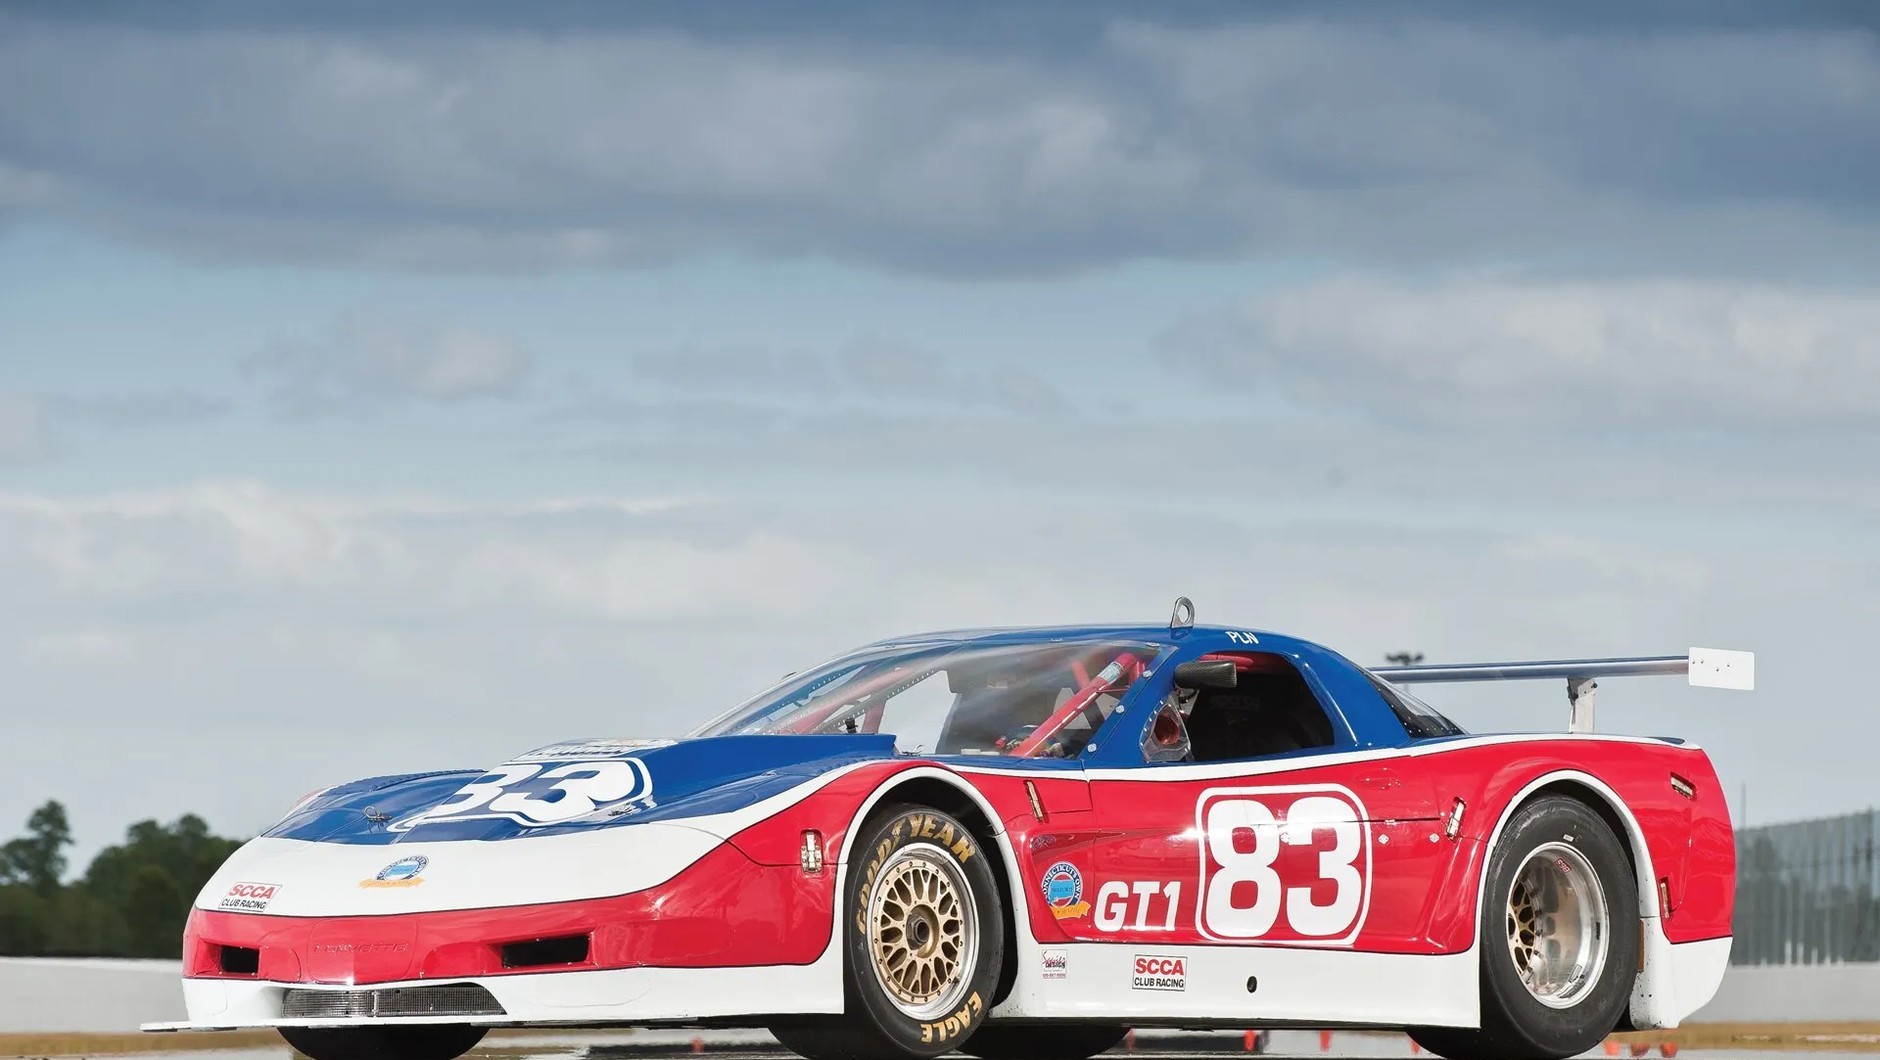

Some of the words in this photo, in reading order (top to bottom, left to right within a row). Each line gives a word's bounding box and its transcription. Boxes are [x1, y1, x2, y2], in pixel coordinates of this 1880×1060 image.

[1225, 631, 1259, 644] PLN
[1205, 796, 1362, 938] 83
[229, 884, 275, 899] SCCA
[221, 898, 240, 907] CLUB
[239, 900, 266, 909] RACING
[1094, 881, 1181, 932] GT1
[1135, 958, 1184, 976] SCCA
[1134, 977, 1155, 987] CLUB
[1155, 978, 1184, 988] RACING
[920, 991, 982, 1043] EAGLE
